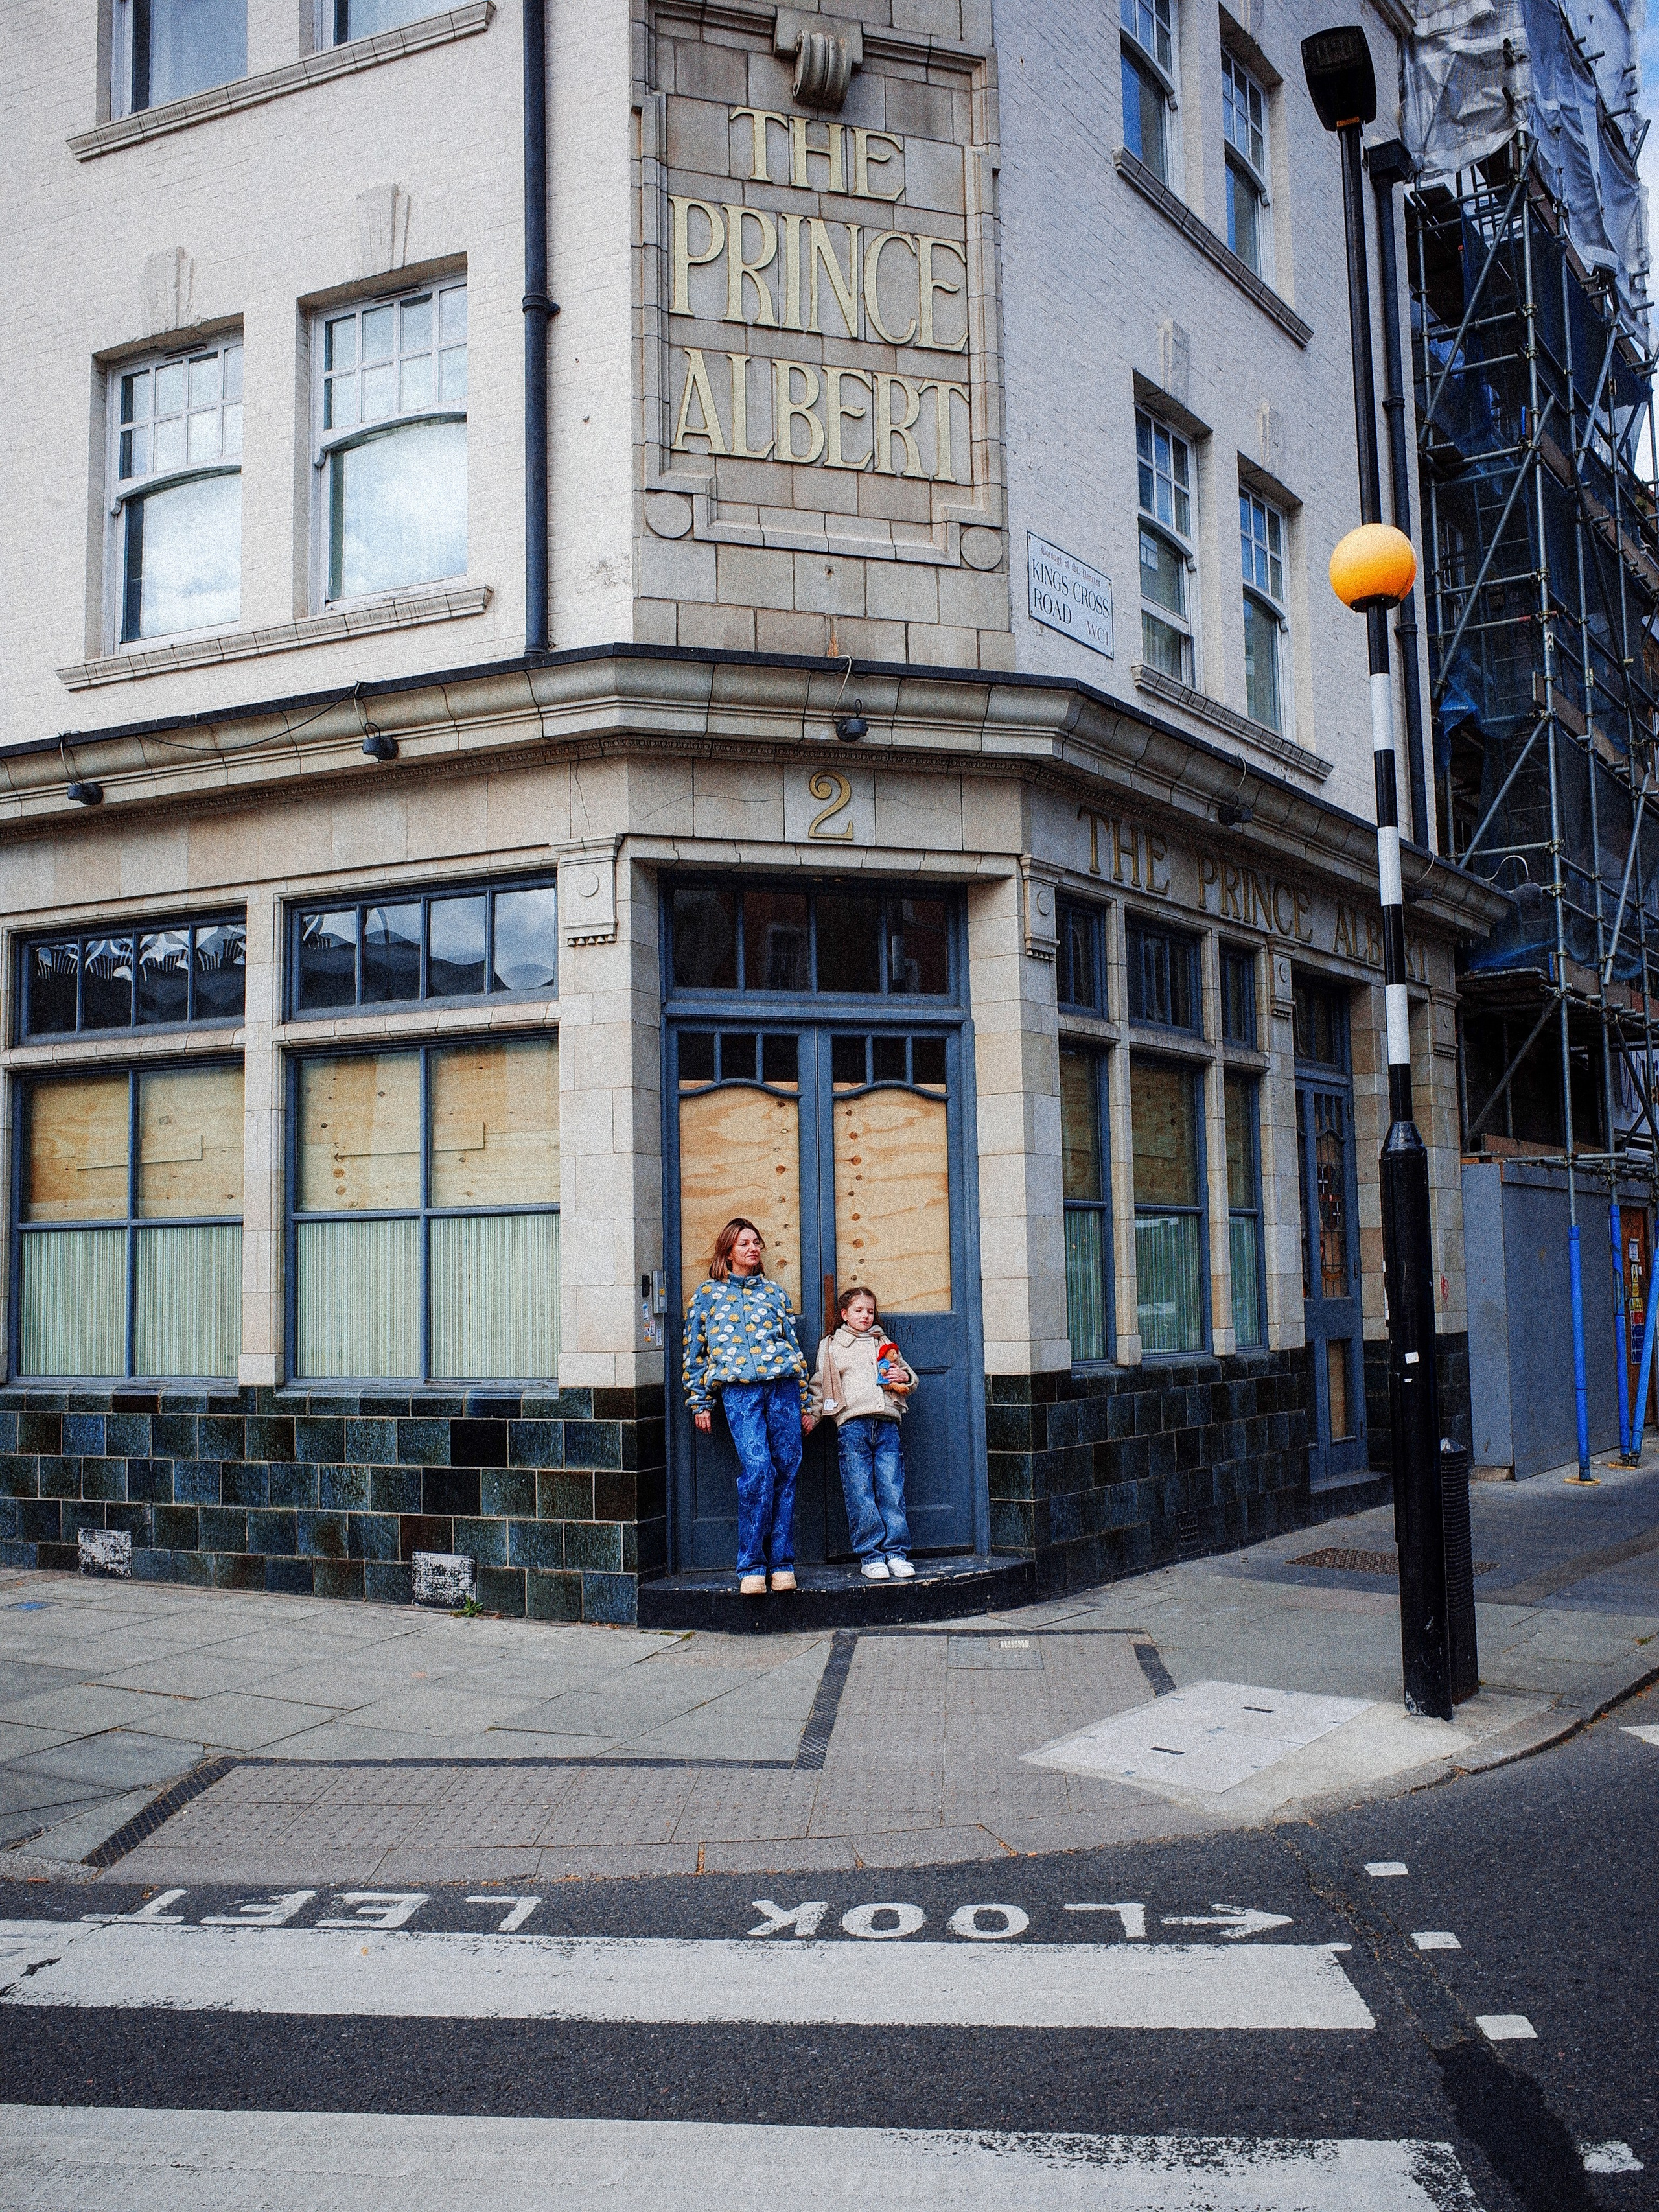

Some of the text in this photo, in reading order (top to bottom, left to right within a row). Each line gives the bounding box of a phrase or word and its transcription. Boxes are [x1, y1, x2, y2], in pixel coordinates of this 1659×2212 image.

[729, 106, 904, 202] THE
[669, 195, 968, 352] PRINCE
[670, 348, 969, 482] ALBERT
[1032, 559, 1109, 618] KINGS CROSS
[1041, 546, 1063, 566] Borough
[1034, 588, 1071, 624] ROAD
[809, 769, 853, 840] 2
[1077, 805, 1170, 895] THE
[1196, 853, 1312, 944] PRINCE
[80, 1889, 1146, 1938] LOOK LEFT
